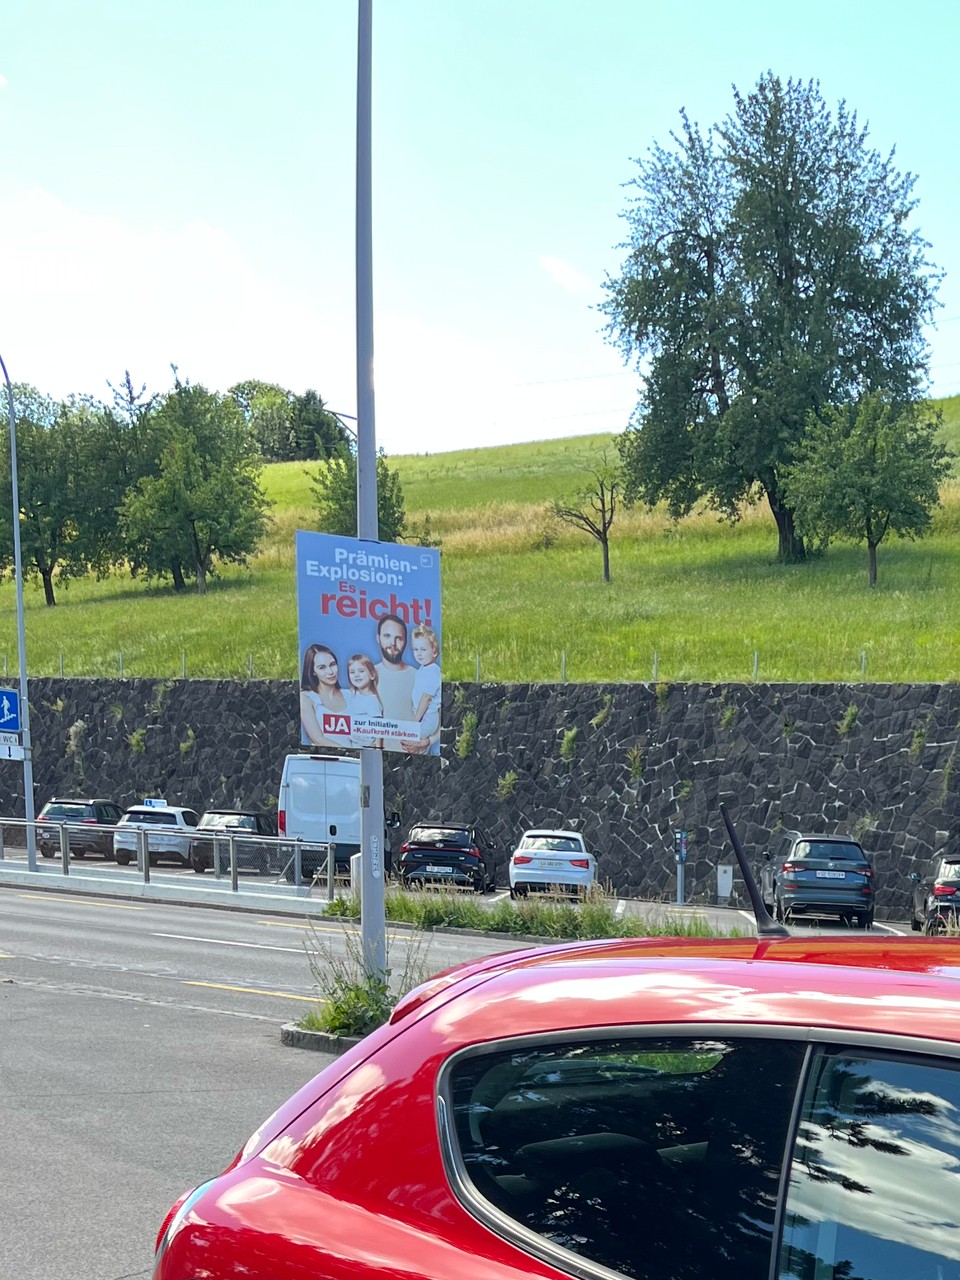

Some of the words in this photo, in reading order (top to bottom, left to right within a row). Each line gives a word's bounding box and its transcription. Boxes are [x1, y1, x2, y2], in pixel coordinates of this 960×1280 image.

[334, 548, 418, 573] Prämien-
[306, 560, 403, 586] Explosion:
[338, 581, 356, 593] Es
[321, 590, 432, 627] reicht!
[325, 717, 349, 732] JA
[368, 720, 398, 728] Initiative
